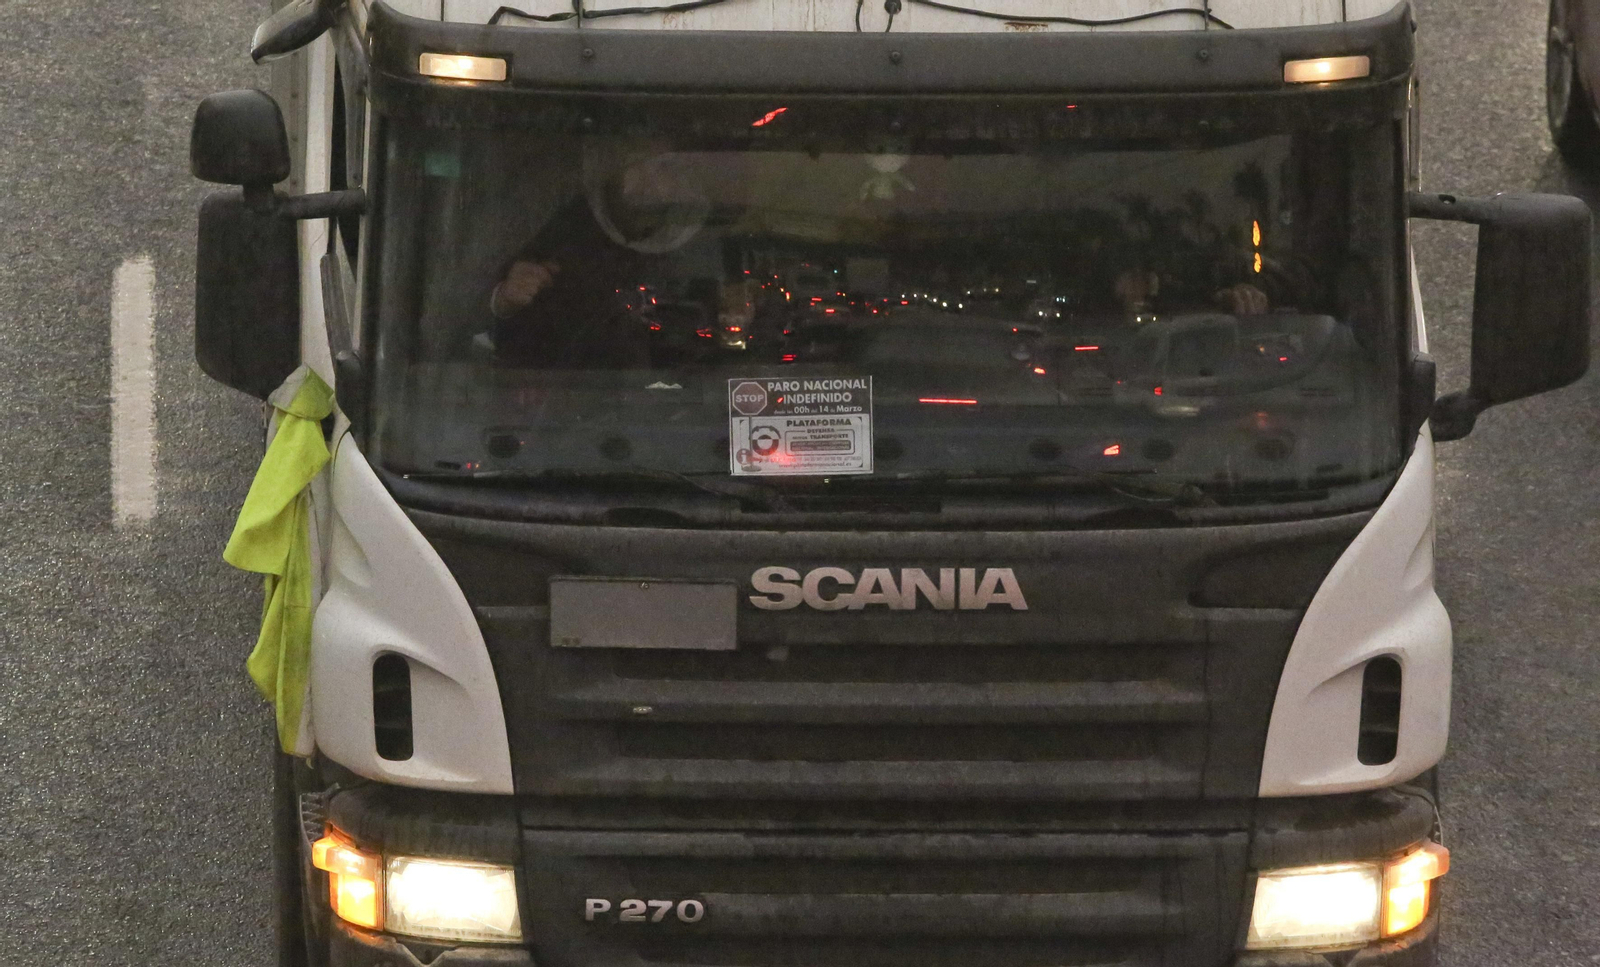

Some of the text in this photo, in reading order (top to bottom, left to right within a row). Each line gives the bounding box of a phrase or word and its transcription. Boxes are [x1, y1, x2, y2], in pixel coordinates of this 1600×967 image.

[768, 379, 867, 392] PARO NACIONAL
[735, 394, 764, 403] STOP
[783, 392, 852, 404] INDEFINIDO
[794, 406, 810, 414] 00h
[819, 405, 829, 413] 14
[836, 404, 863, 413] Marzo
[786, 419, 852, 427] PLATAFORMA
[749, 566, 1028, 610] SCANIA
[585, 898, 704, 923] P 270
